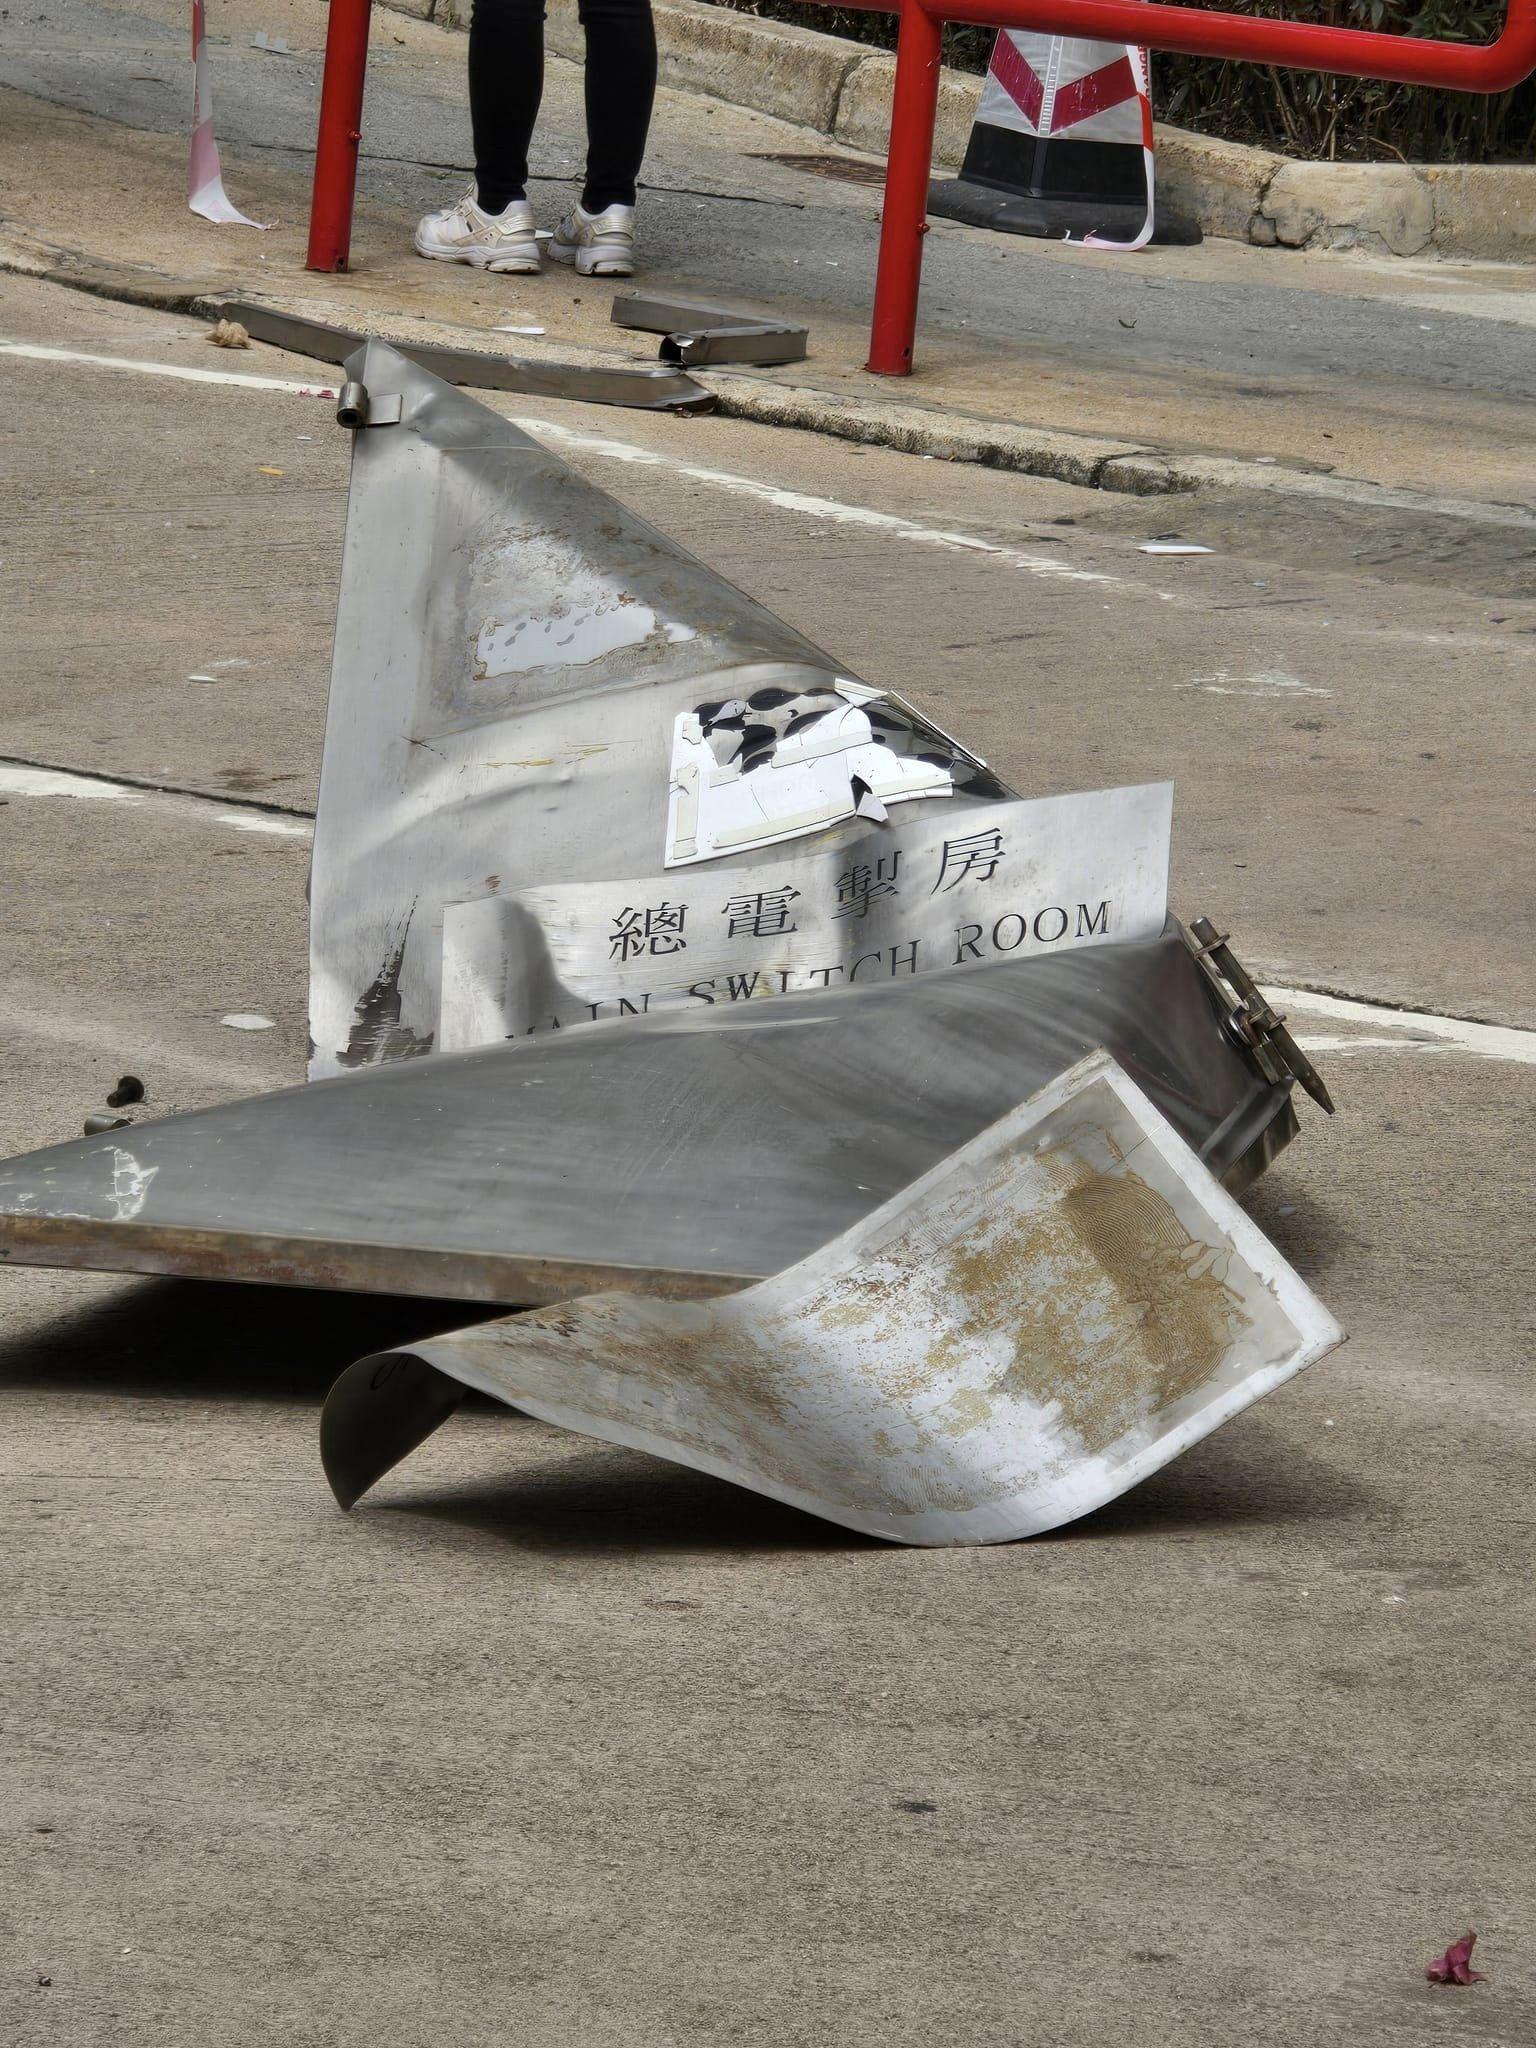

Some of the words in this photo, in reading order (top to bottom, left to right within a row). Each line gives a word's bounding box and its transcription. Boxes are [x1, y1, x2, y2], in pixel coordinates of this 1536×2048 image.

[610, 828, 1006, 962] 總電掣房
[952, 900, 1112, 966] ROOM
